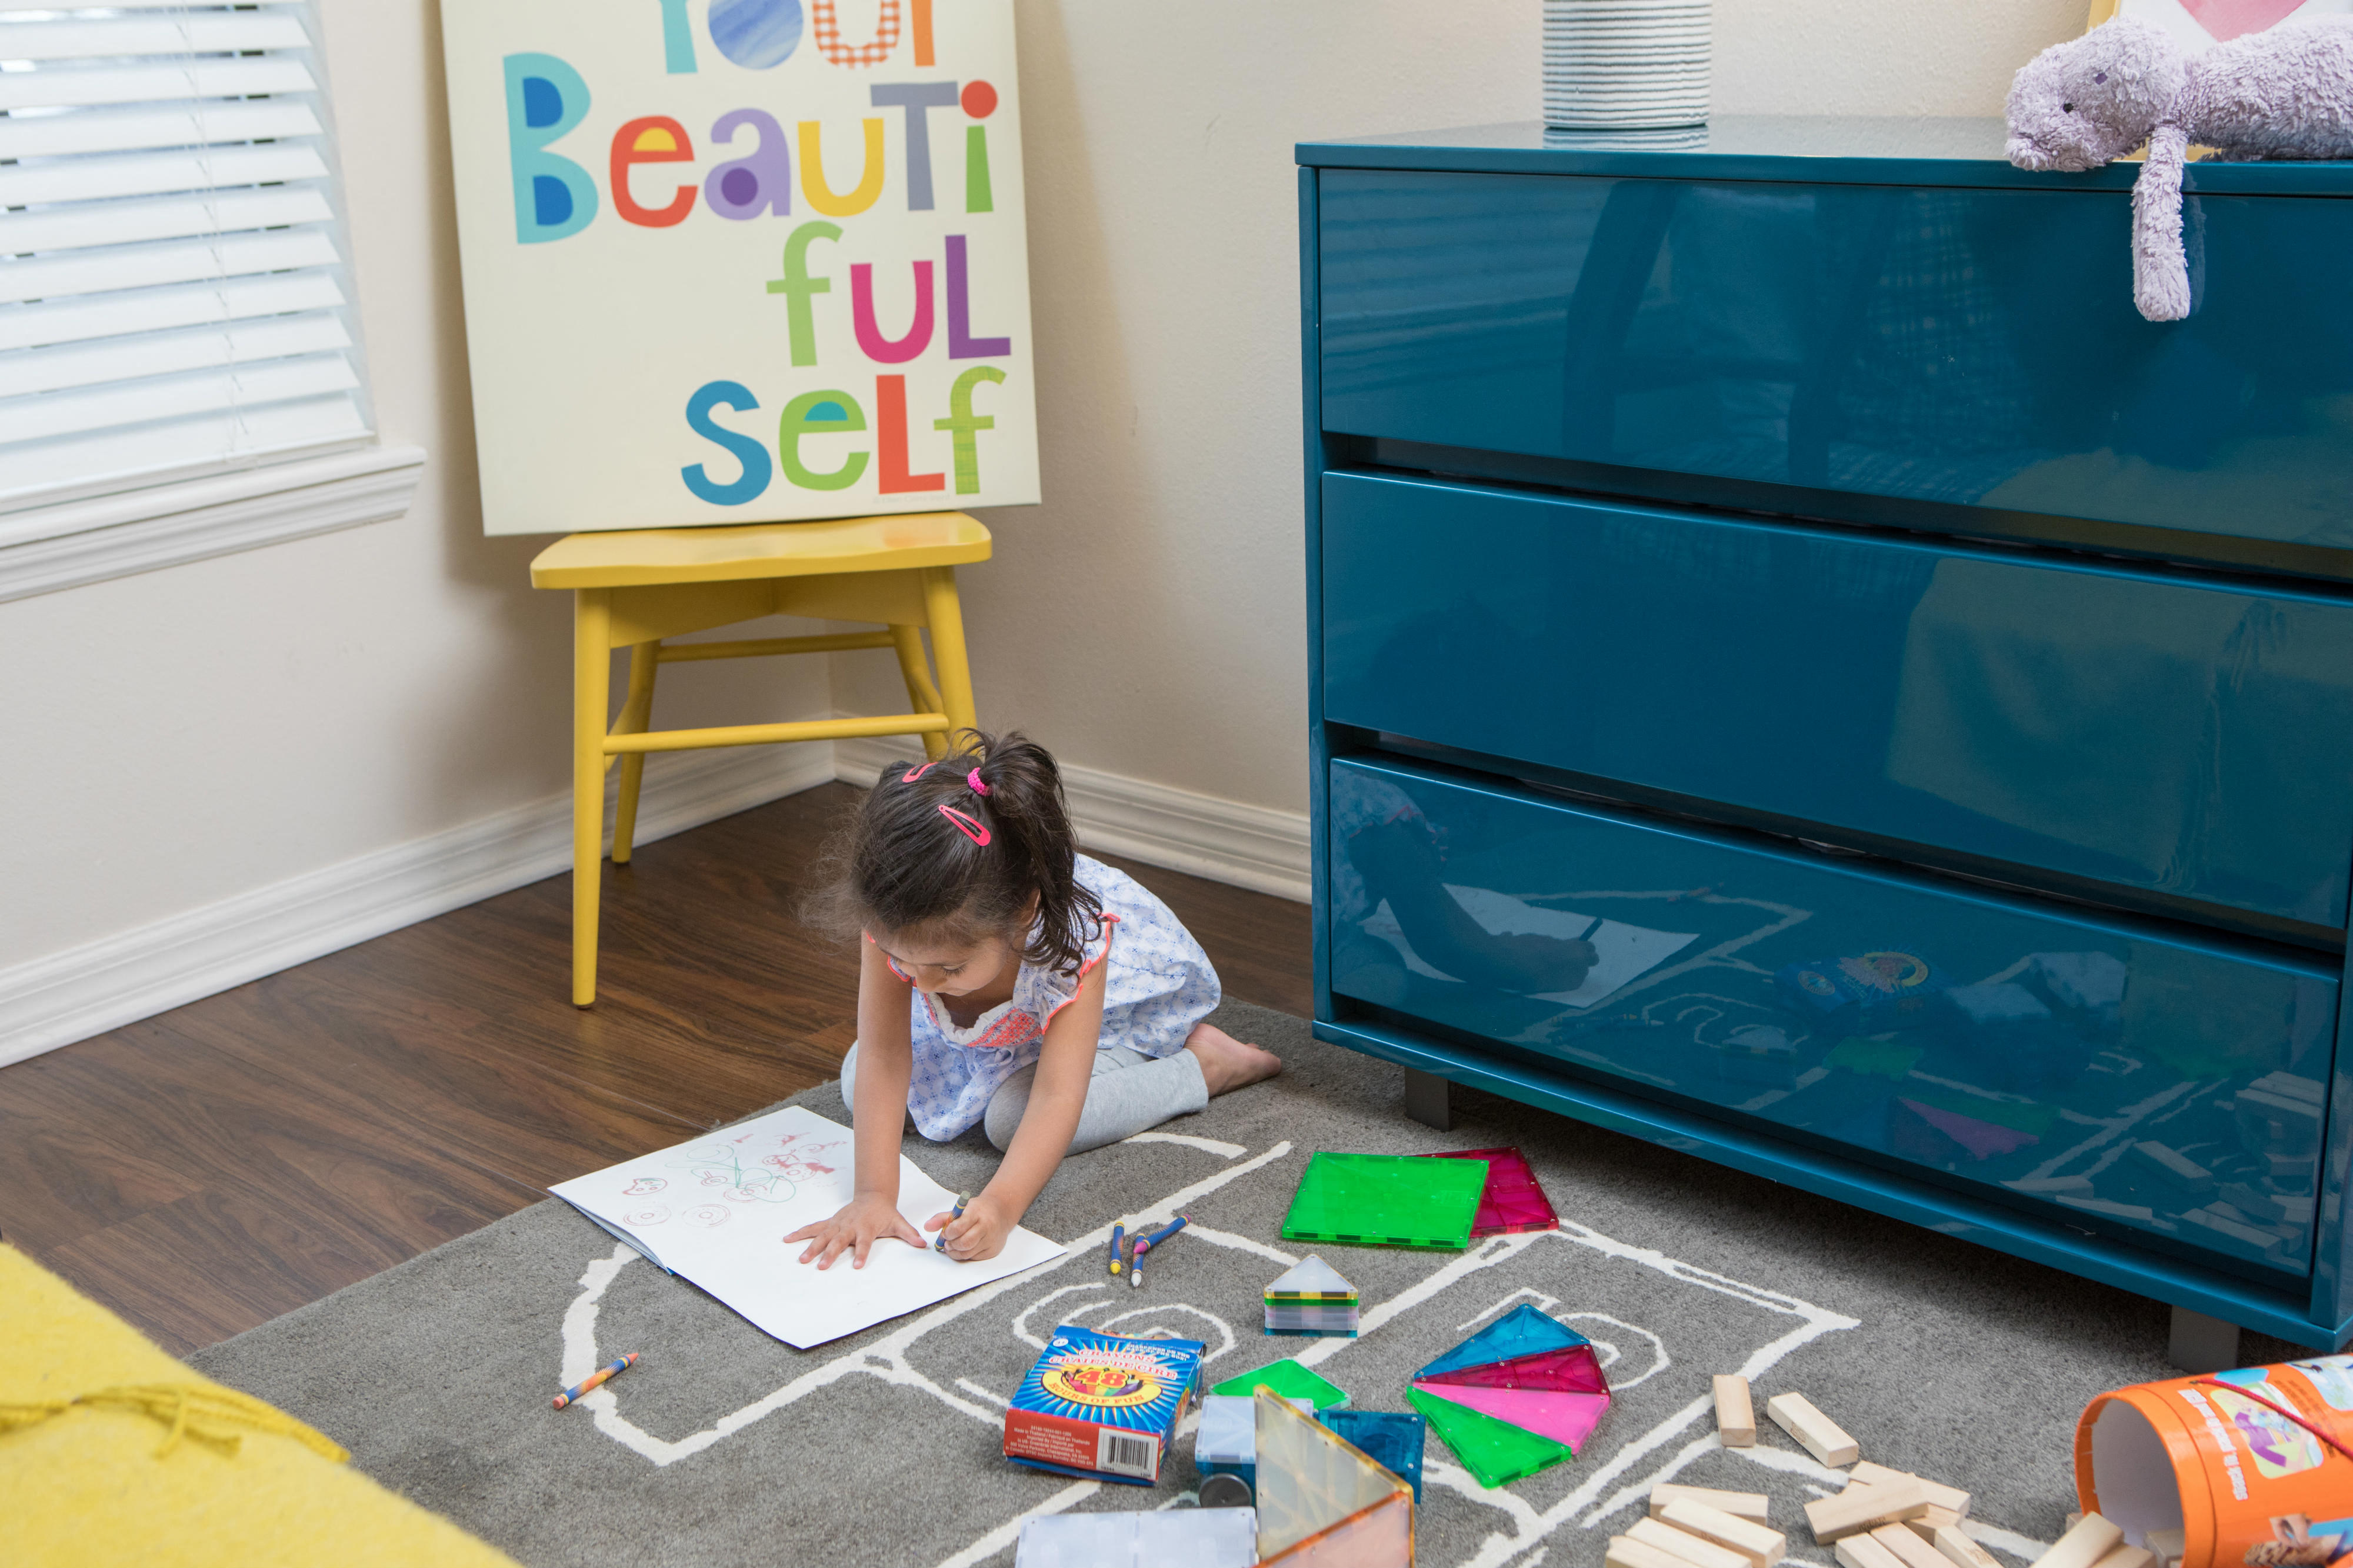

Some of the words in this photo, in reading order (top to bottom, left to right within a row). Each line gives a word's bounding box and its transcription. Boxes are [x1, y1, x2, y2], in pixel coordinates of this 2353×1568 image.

[1079, 1350, 1156, 1363] CRAYONS
[1049, 1356, 1109, 1367] CRAIES
[1111, 1360, 1135, 1370] DE
[1136, 1364, 1178, 1380] CIRE
[1075, 1369, 1129, 1389] 48
[1049, 1382, 1088, 1402] HOURS
[1091, 1396, 1110, 1404] OF
[1114, 1394, 1145, 1404] FUN
